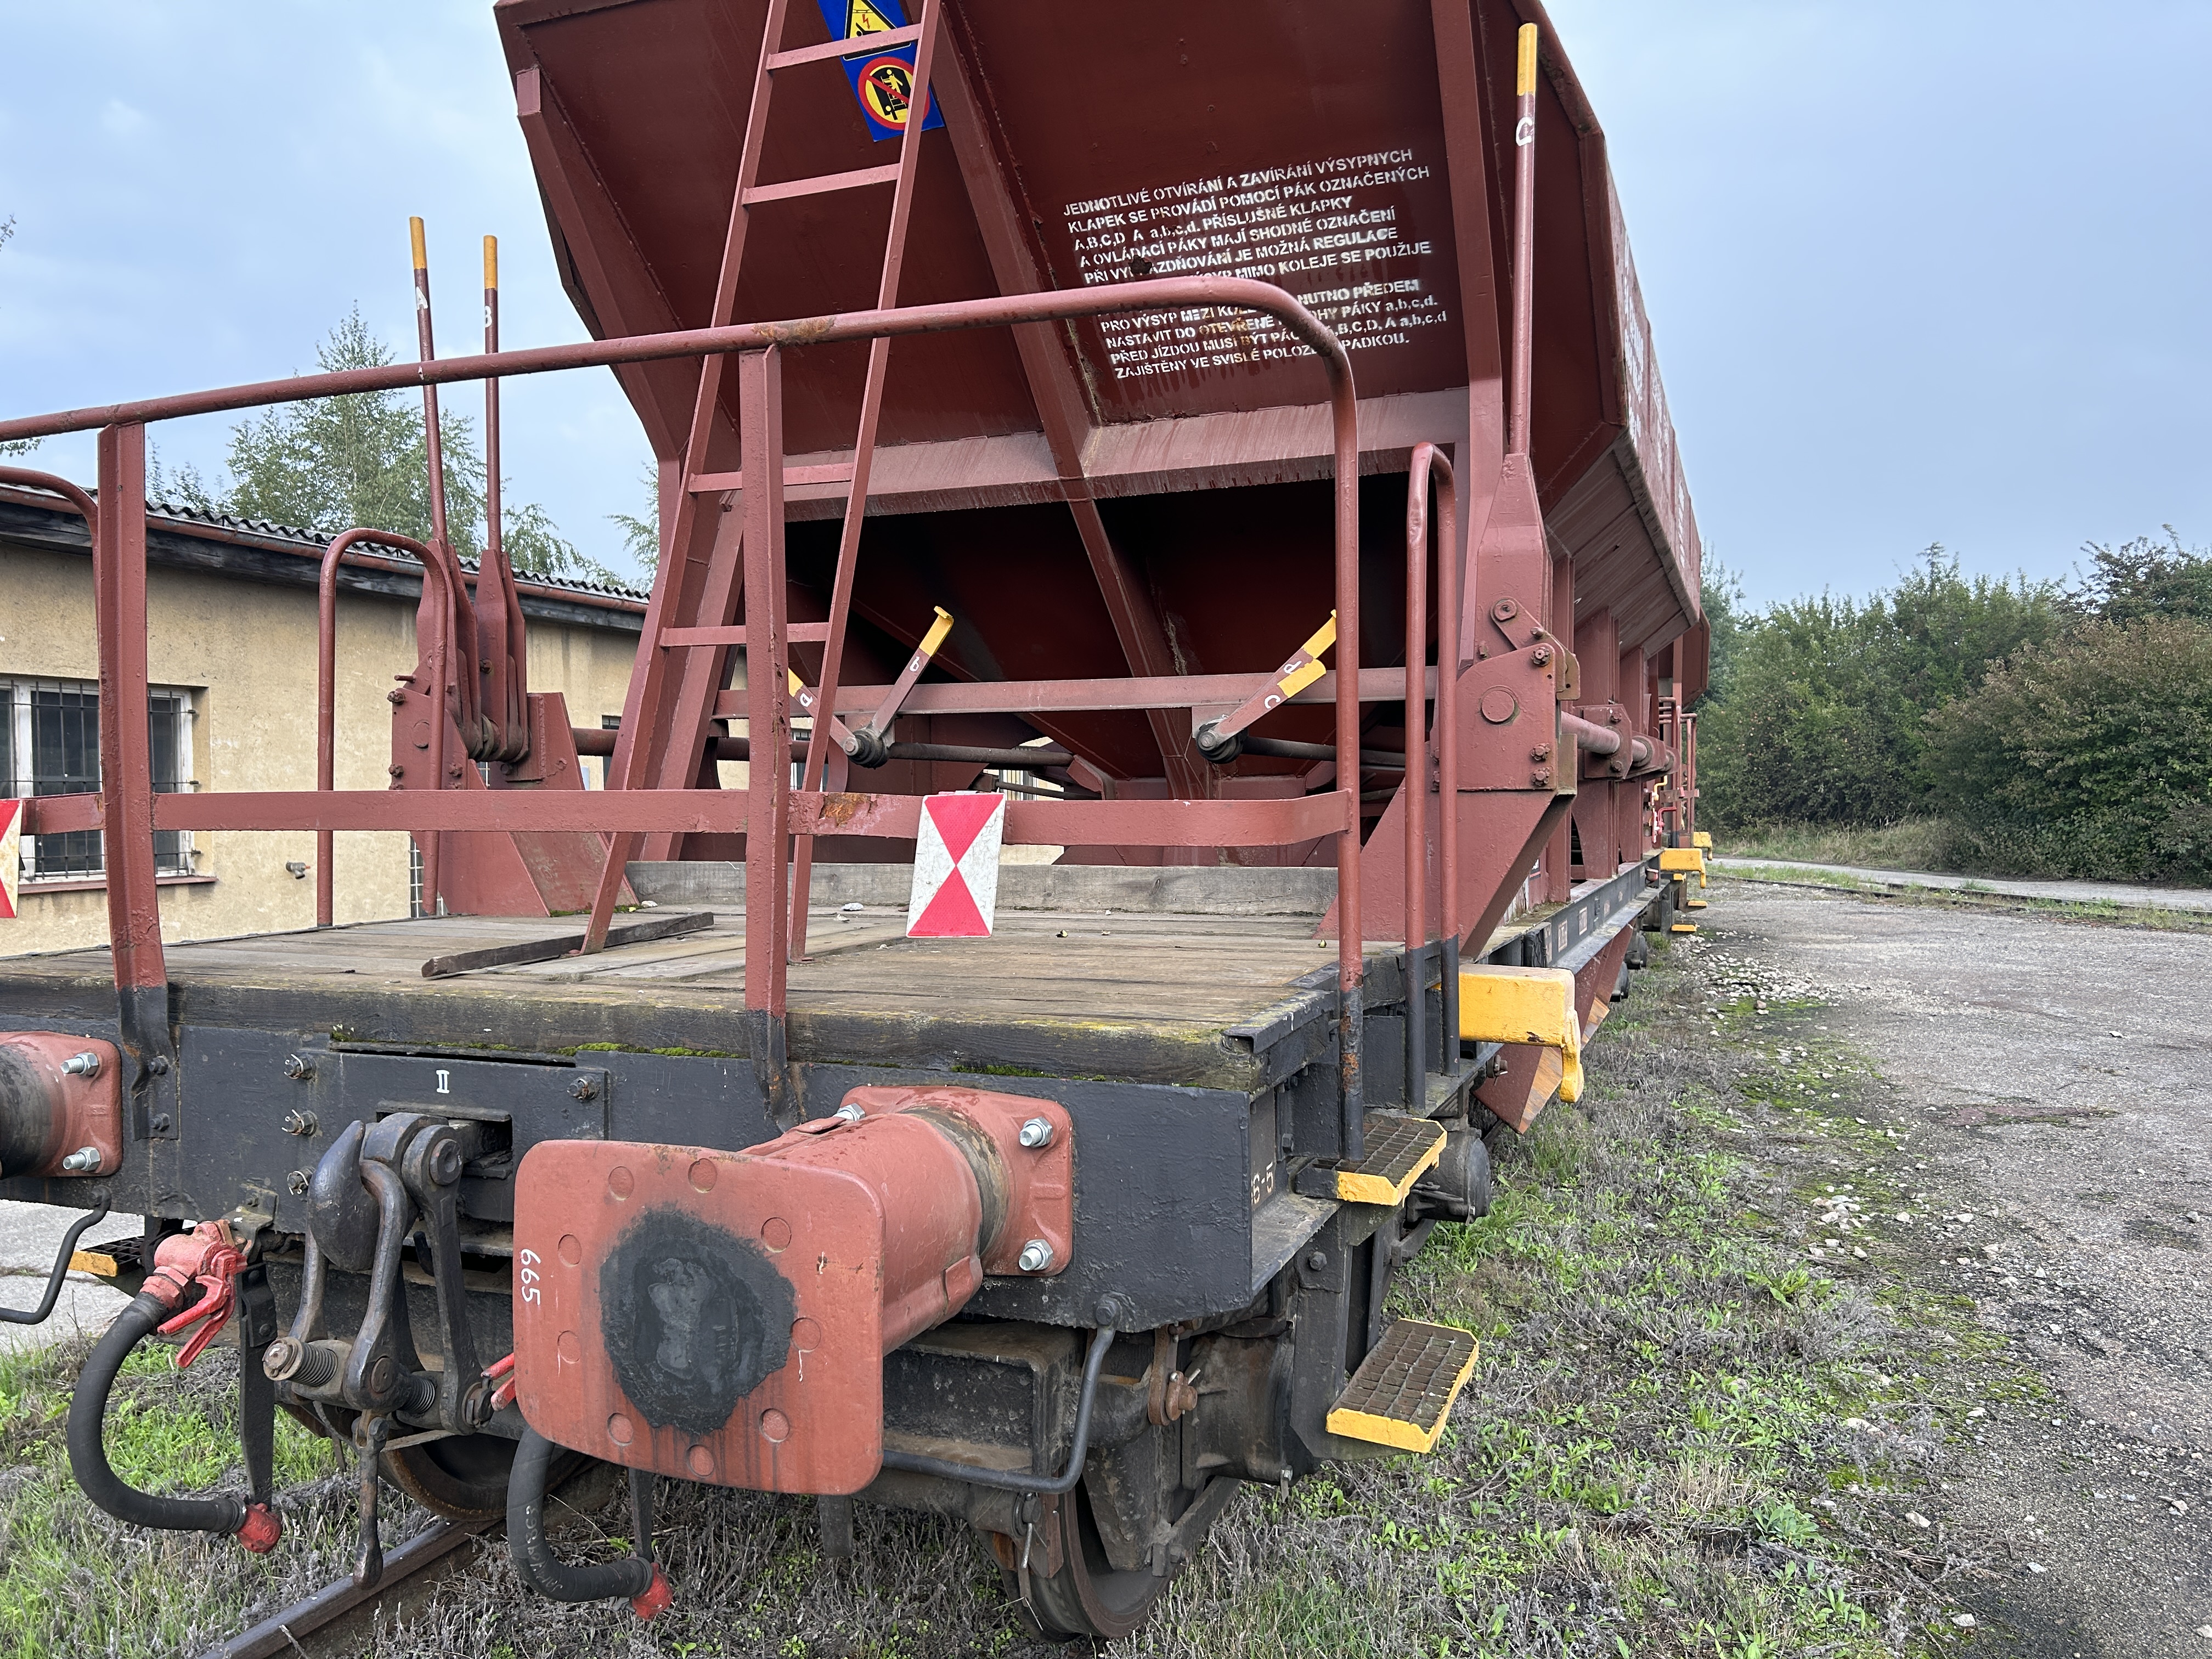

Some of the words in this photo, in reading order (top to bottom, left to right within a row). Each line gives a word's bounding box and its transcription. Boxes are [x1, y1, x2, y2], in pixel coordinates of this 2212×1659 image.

[1516, 116, 1533, 146] C
[1063, 188, 1151, 216] JEDNOTLIVÉ
[1153, 176, 1223, 200] OTVÍRÁNÍ
[1227, 176, 1238, 189] A
[1240, 160, 1312, 187] ZAVÍRÁNÍ
[1068, 213, 1126, 234] KLAPEK
[1128, 210, 1148, 224] SE
[1150, 195, 1216, 221] PROVÁDÍ
[1219, 185, 1280, 209] POMOCÍ
[1283, 182, 1317, 199] PÁK
[1319, 166, 1430, 193] OZNAČENÝCH
[1075, 232, 1125, 251] A,B,C,D
[1133, 229, 1144, 241] A
[1202, 202, 1287, 231] PŘÍSLUŠNÉ
[1289, 195, 1353, 217] KLAPKY
[1080, 256, 1091, 268] A
[1093, 240, 1165, 265] OVLÁDACÍ
[1167, 236, 1207, 258] PÁKY
[1211, 228, 1247, 248] MAJÍ
[1249, 218, 1313, 241] SHODNÉ
[1316, 205, 1396, 230] OZNAČENÍ
[1084, 269, 1109, 284] PŘI
[1110, 249, 1232, 280] VYAZDŇOVÁNÍ
[1235, 249, 1253, 263] JE
[1255, 236, 1311, 259] MOŽNÁ
[1313, 227, 1398, 250] REGULACE
[1235, 264, 1276, 279] MIMO
[1278, 254, 1338, 275] KOLEJE
[1340, 250, 1361, 264] SE
[1365, 241, 1432, 261] POUŽIJE
[415, 286, 428, 311] A
[1101, 319, 1130, 332] PRO
[1131, 312, 1177, 329] VÝSYP
[1181, 307, 1215, 323] MEZI
[1297, 288, 1351, 306] NUTNO
[1353, 279, 1420, 298] PŘEDEM
[1105, 329, 1172, 349] NASTAVIT
[1176, 327, 1195, 338] DO
[1199, 313, 1275, 335] OTEVŘENÉ
[1341, 301, 1381, 318] PÁKY
[1385, 295, 1438, 313] a,b,c,d.
[1110, 349, 1148, 365] PŘED
[1152, 342, 1200, 359] JÍZDOU
[1203, 335, 1238, 352] MUSÍ
[1240, 331, 1267, 346] BÝT
[1385, 316, 1397, 329] A
[1400, 311, 1447, 329] a,b,c,d
[1115, 359, 1187, 379] ZAJIŠTĚNY
[1190, 356, 1210, 369] VE
[1213, 348, 1261, 366] SVISLÉ
[436, 1069, 450, 1094] II
[1251, 1161, 1274, 1205] 6-5
[521, 1249, 541, 1306] 665
